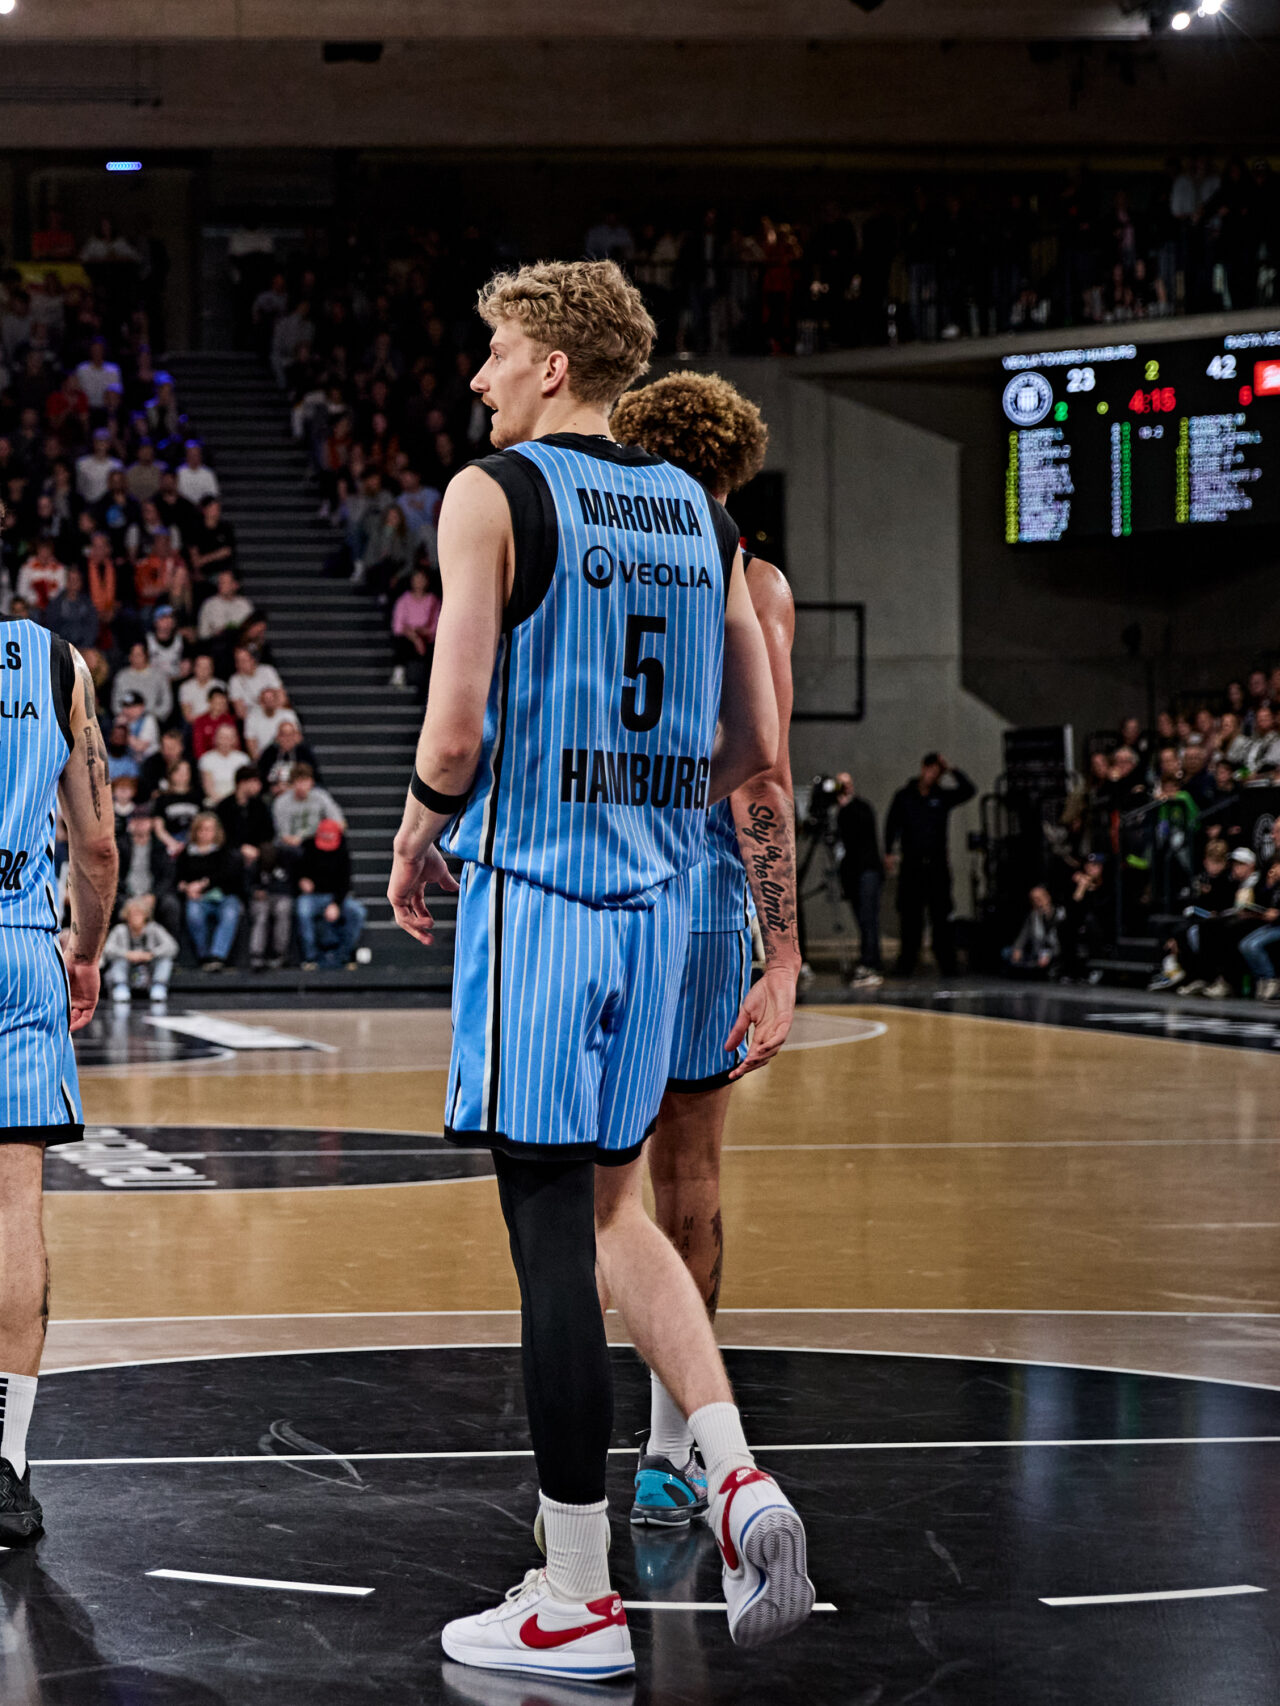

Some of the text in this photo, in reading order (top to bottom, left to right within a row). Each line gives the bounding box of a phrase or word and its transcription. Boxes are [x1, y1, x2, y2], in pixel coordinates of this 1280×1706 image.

[1066, 367, 1096, 393] 23
[1145, 360, 1160, 381] 2
[1206, 354, 1237, 380] 42
[1128, 387, 1177, 415] 4:15
[576, 487, 702, 537] MARONKA
[619, 560, 712, 589] VEOLIA
[620, 614, 667, 733] 5
[561, 748, 709, 810] HAMBURG
[742, 802, 790, 934] Sky is the limit
